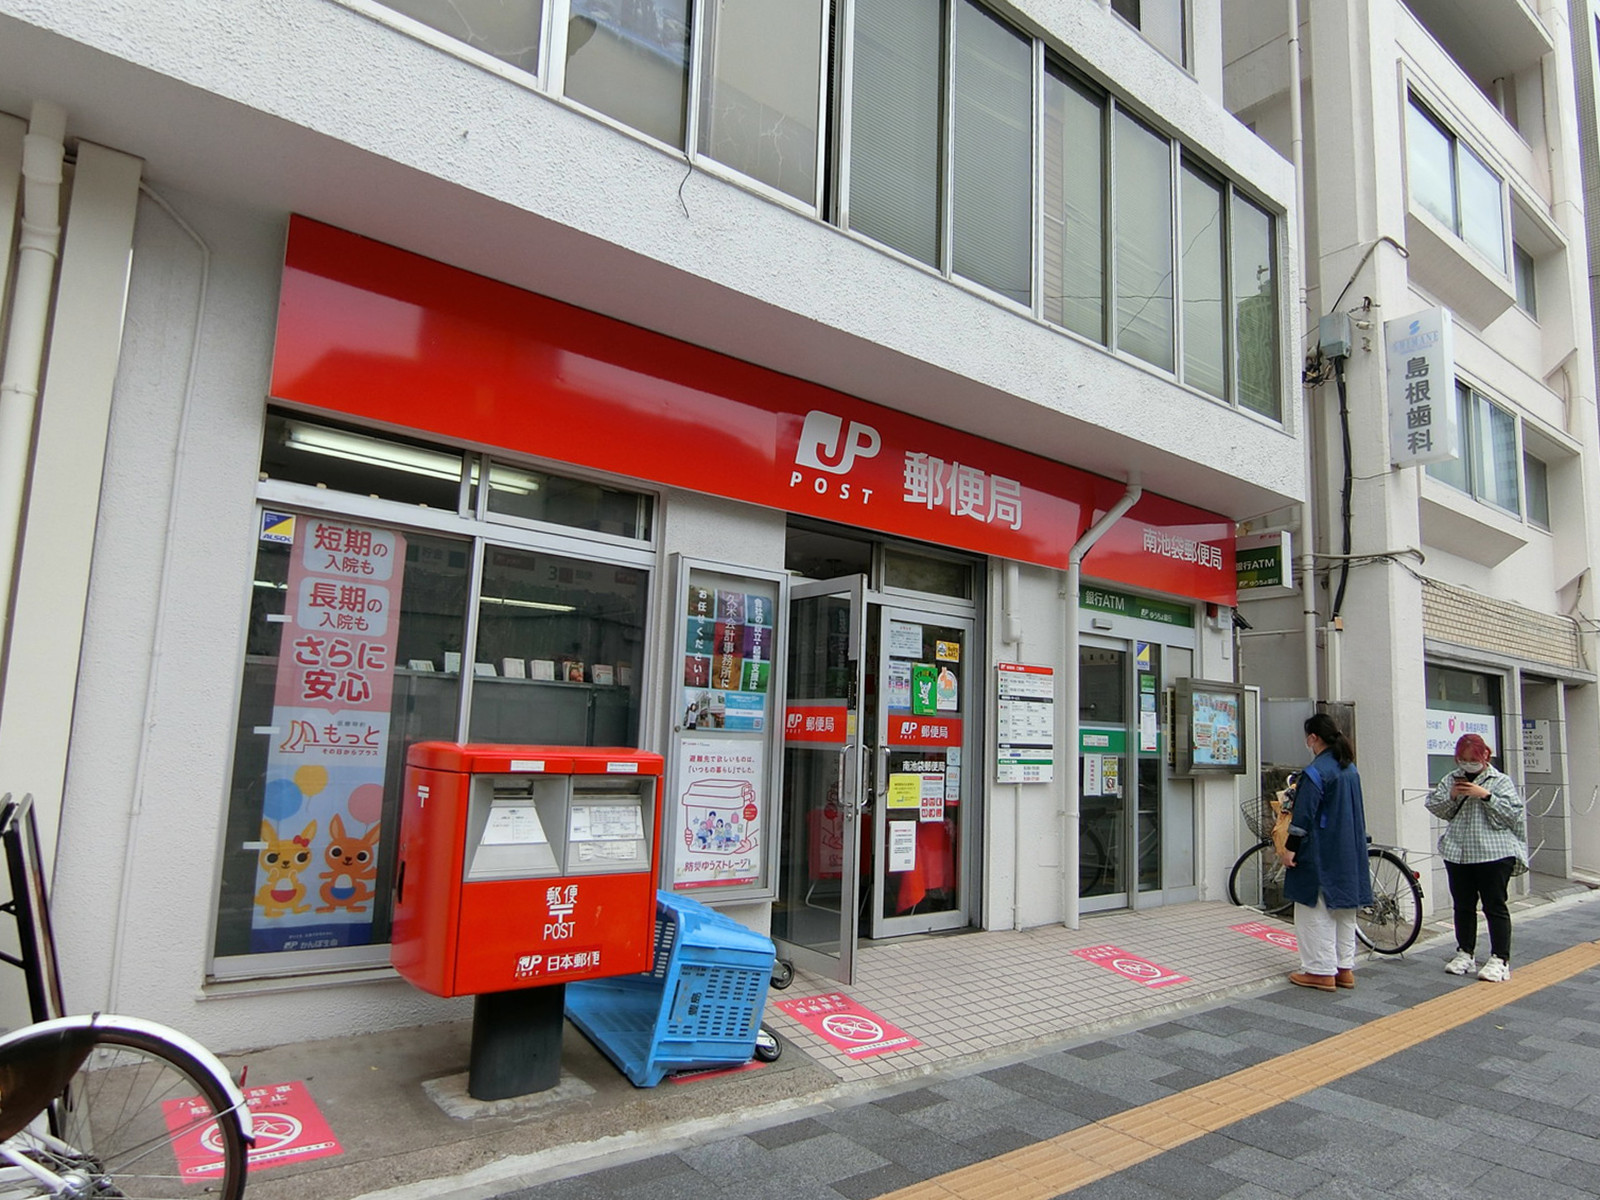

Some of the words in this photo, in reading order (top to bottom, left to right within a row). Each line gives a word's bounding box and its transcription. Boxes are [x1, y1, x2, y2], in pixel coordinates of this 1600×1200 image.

[1405, 356, 1433, 455] 島根歯科
[795, 410, 881, 475] JP
[790, 471, 873, 504] POST
[903, 450, 1022, 531] 郵便局
[262, 533, 291, 543] ALSOK
[314, 523, 388, 557] 短期の
[1143, 528, 1223, 570] 南池袋郵便局
[325, 554, 375, 574] 入院も
[308, 582, 383, 615] 長期の
[1085, 590, 1125, 611] 銀行ATM
[319, 611, 369, 631] 入院も
[294, 635, 386, 670] さらに
[720, 594, 736, 689] 久米会計事務所に
[303, 668, 370, 702] 安心
[323, 723, 380, 745] もっと
[805, 716, 835, 732] 郵便局
[900, 721, 918, 735] JP
[921, 724, 949, 739] 郵便局
[322, 748, 378, 756] その日からプラス
[902, 760, 945, 772] 南池袋郵便局
[546, 884, 578, 906] 郵便
[543, 921, 576, 941] POST
[516, 954, 542, 972] JP
[547, 950, 600, 972] 日本郵便
